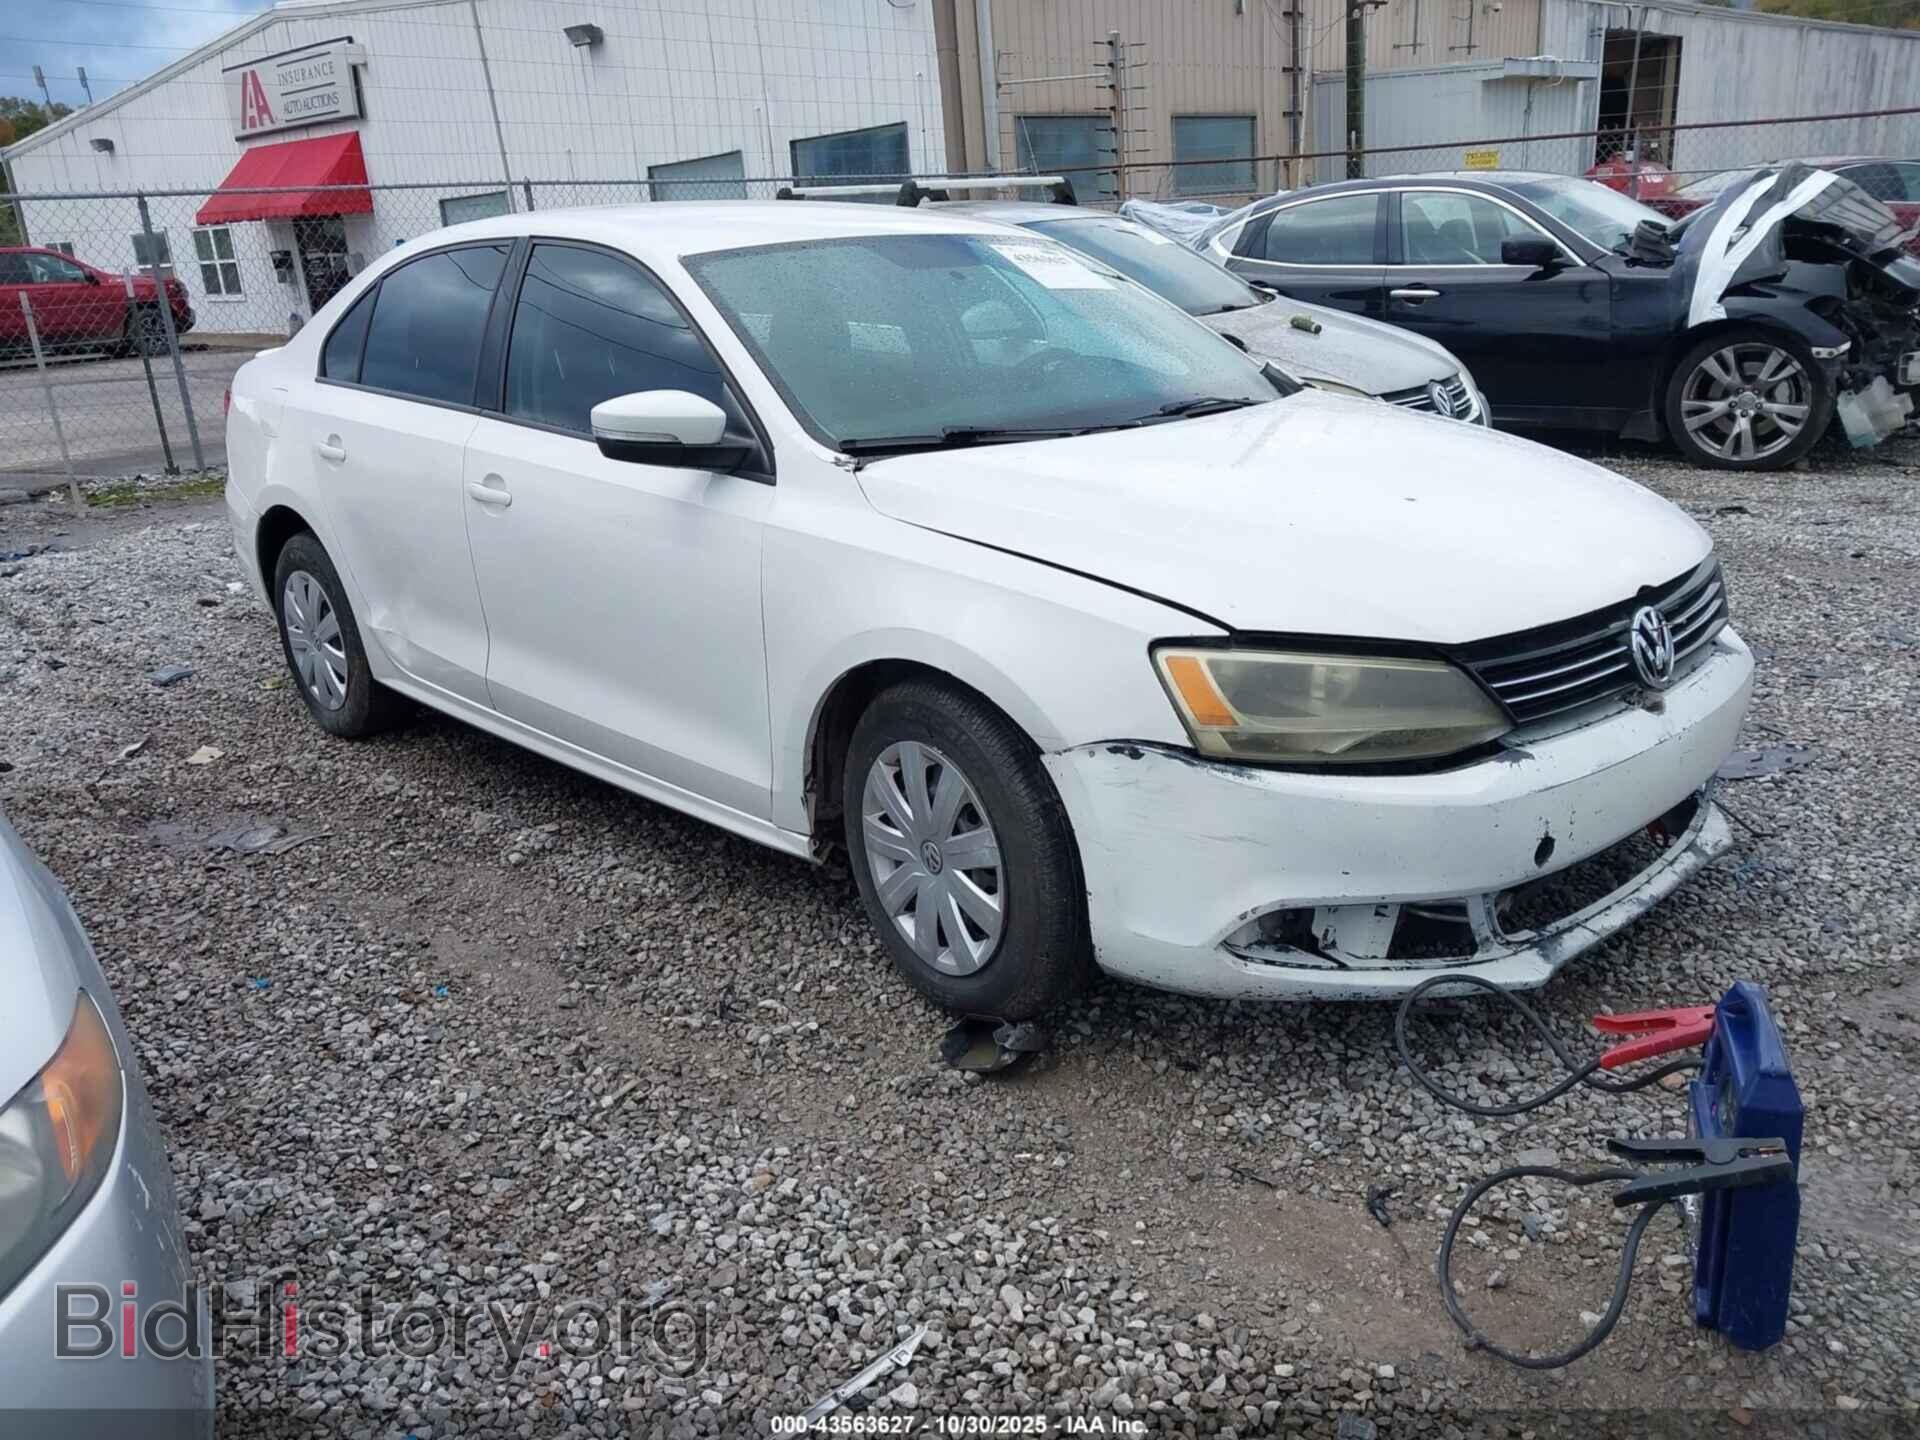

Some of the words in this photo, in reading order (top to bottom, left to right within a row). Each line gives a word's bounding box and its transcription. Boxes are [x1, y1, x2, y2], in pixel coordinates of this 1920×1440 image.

[278, 61, 335, 87] INSURANCE
[283, 98, 303, 114] AUTO
[303, 91, 340, 111] AUCTIONS
